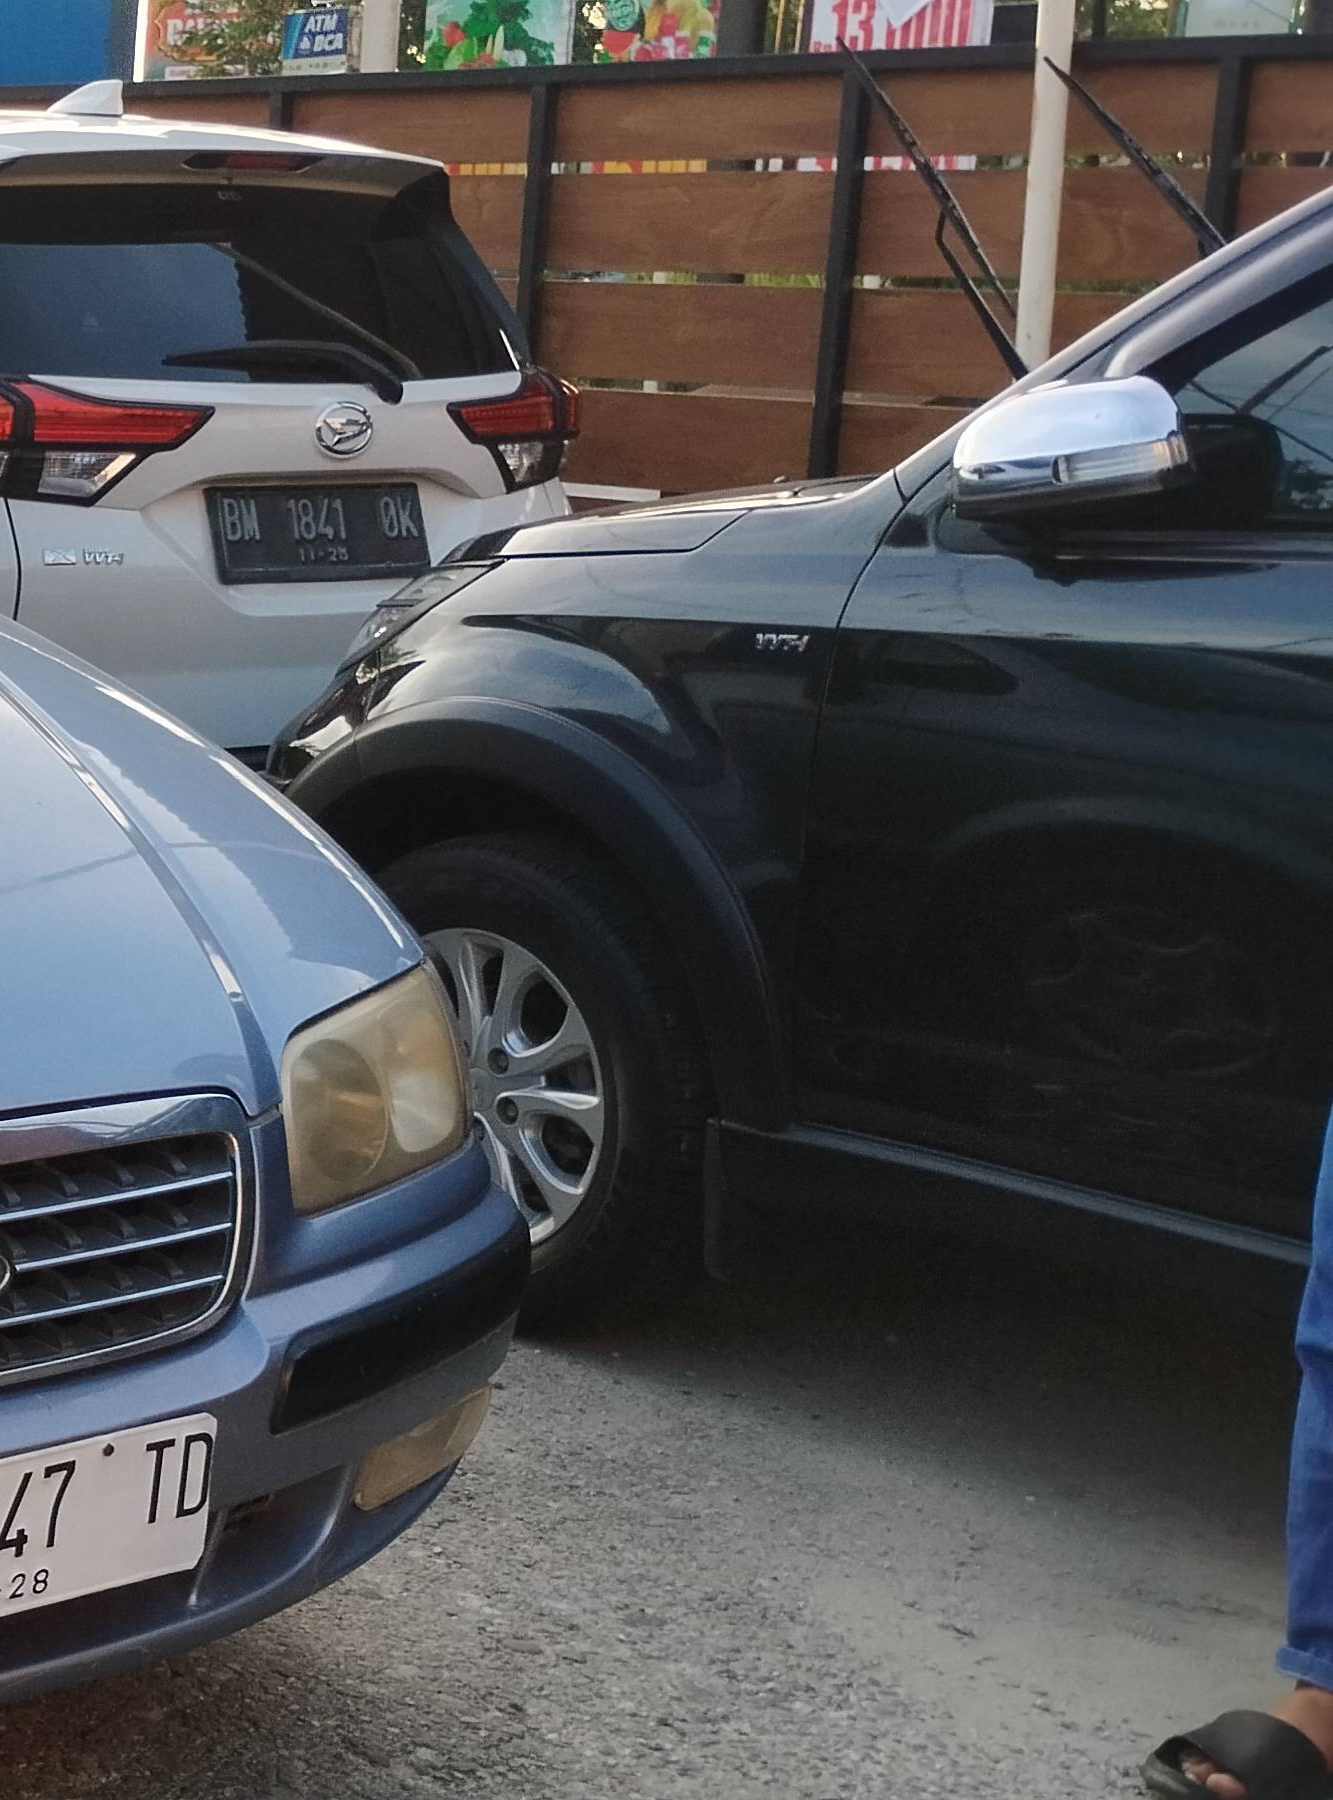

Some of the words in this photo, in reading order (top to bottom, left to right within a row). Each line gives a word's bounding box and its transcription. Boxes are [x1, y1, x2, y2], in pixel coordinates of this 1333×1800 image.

[304, 13, 338, 33] ATM
[223, 498, 260, 541] BM
[287, 498, 346, 540] 1841
[146, 1432, 213, 1524] TD
